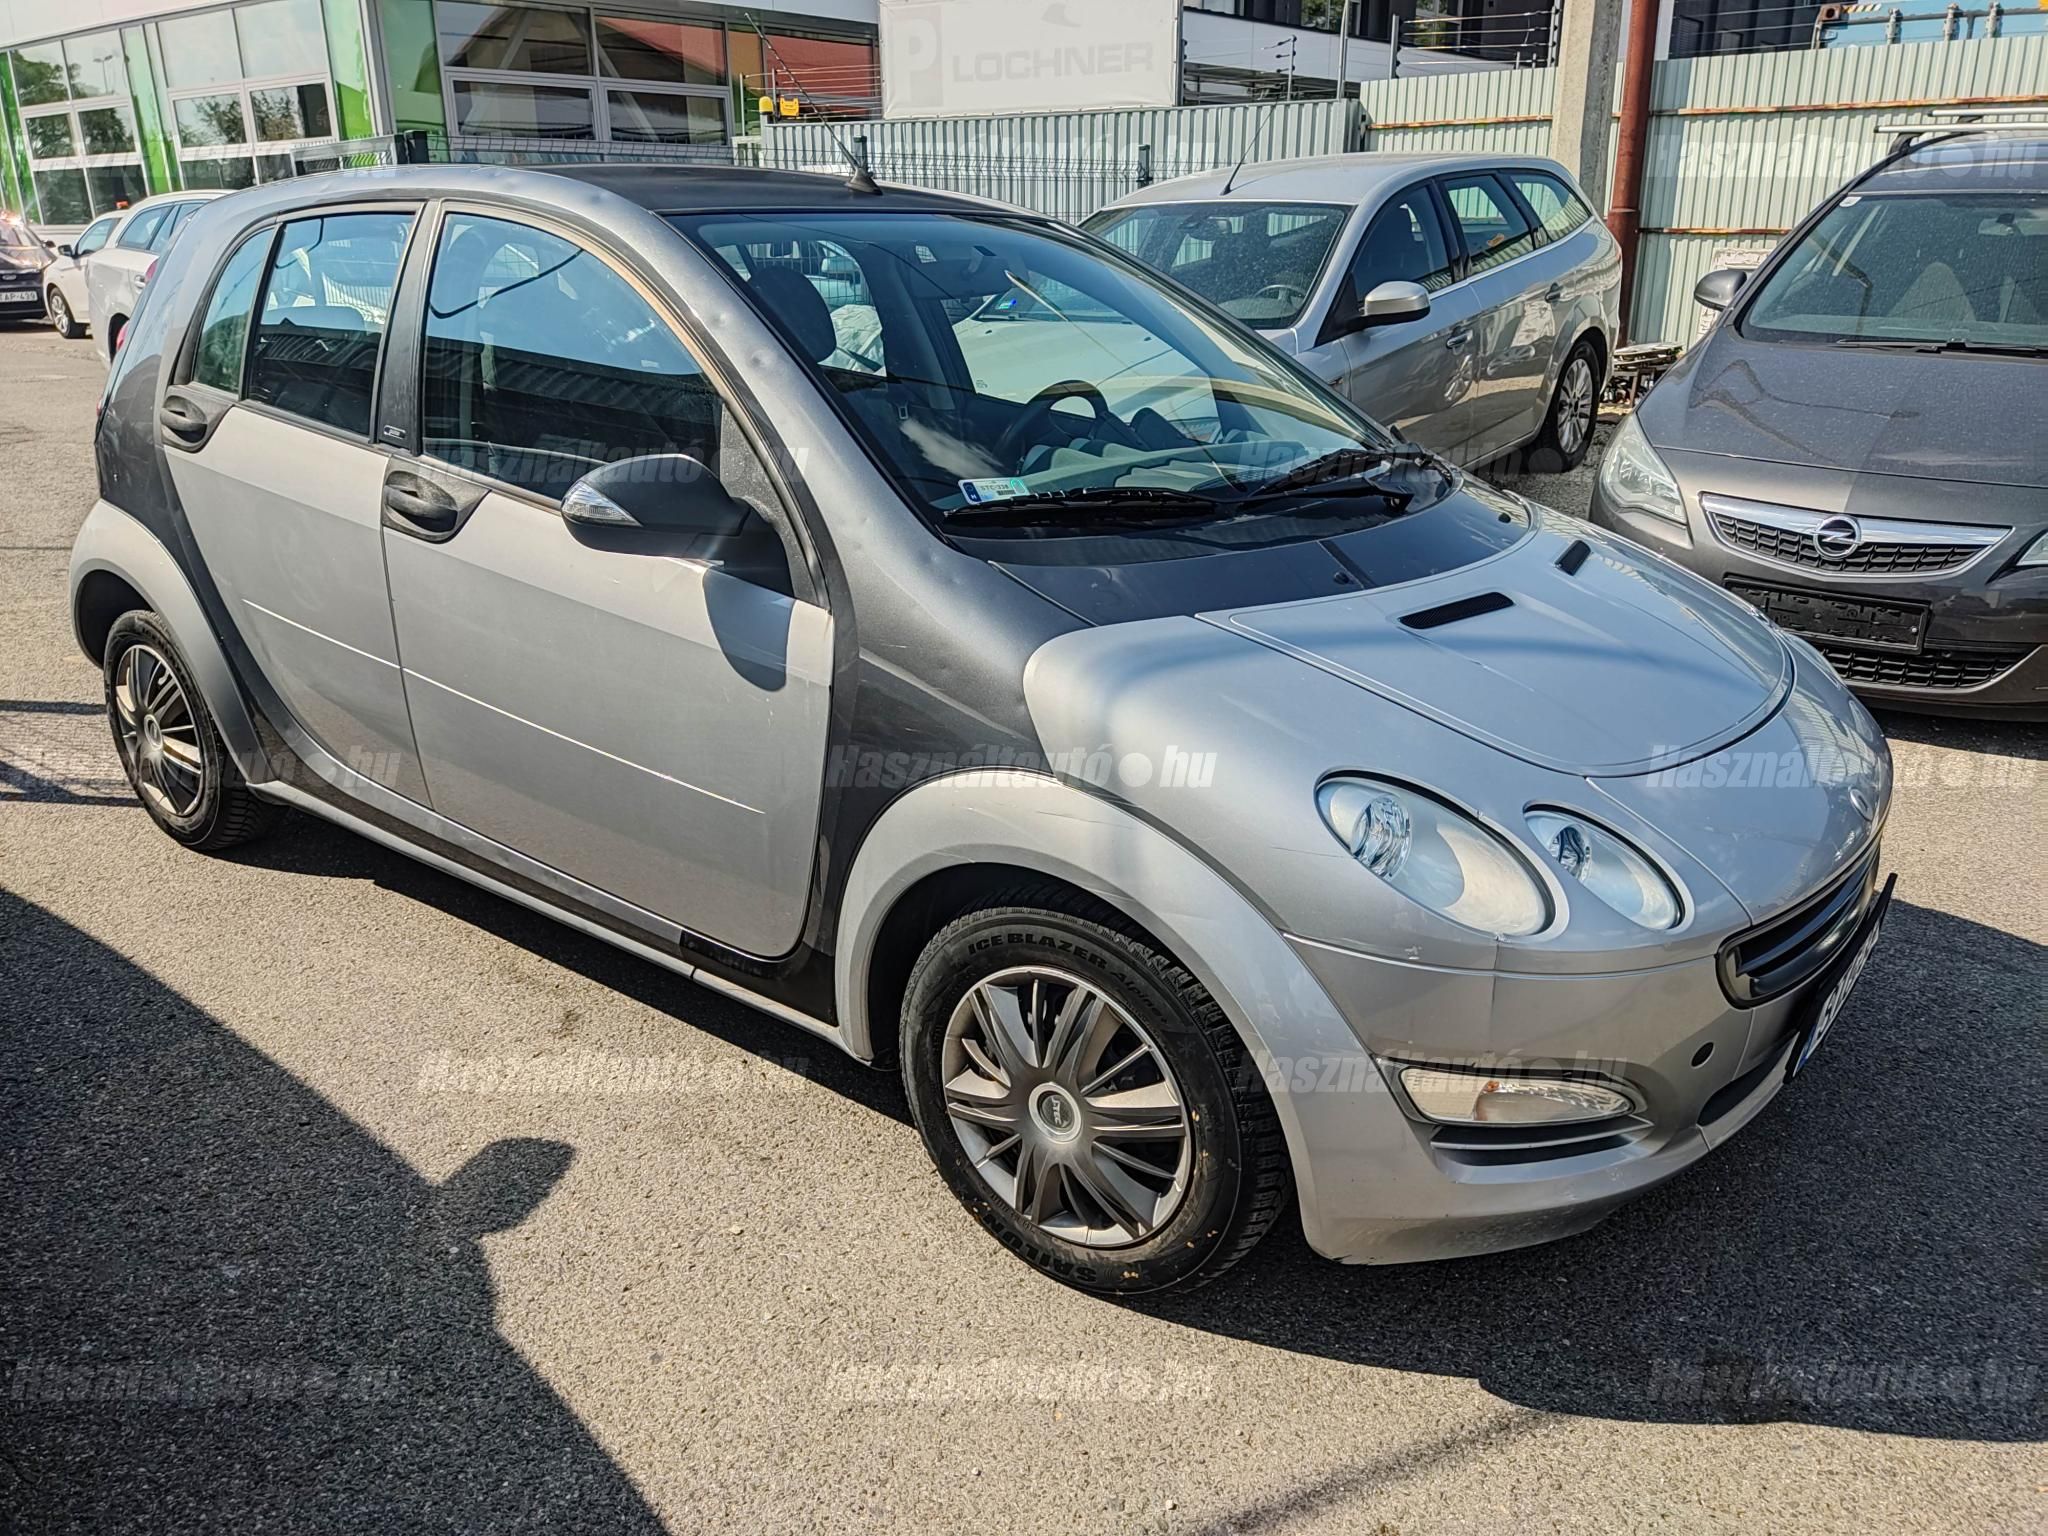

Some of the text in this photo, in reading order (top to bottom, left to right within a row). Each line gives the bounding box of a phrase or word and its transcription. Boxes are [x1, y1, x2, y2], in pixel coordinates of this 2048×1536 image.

[952, 41, 1154, 83] LOCHNER
[968, 934, 1003, 954] ICE
[1007, 932, 1108, 969] BLAZER
[982, 1213, 1098, 1283] SAILUN
